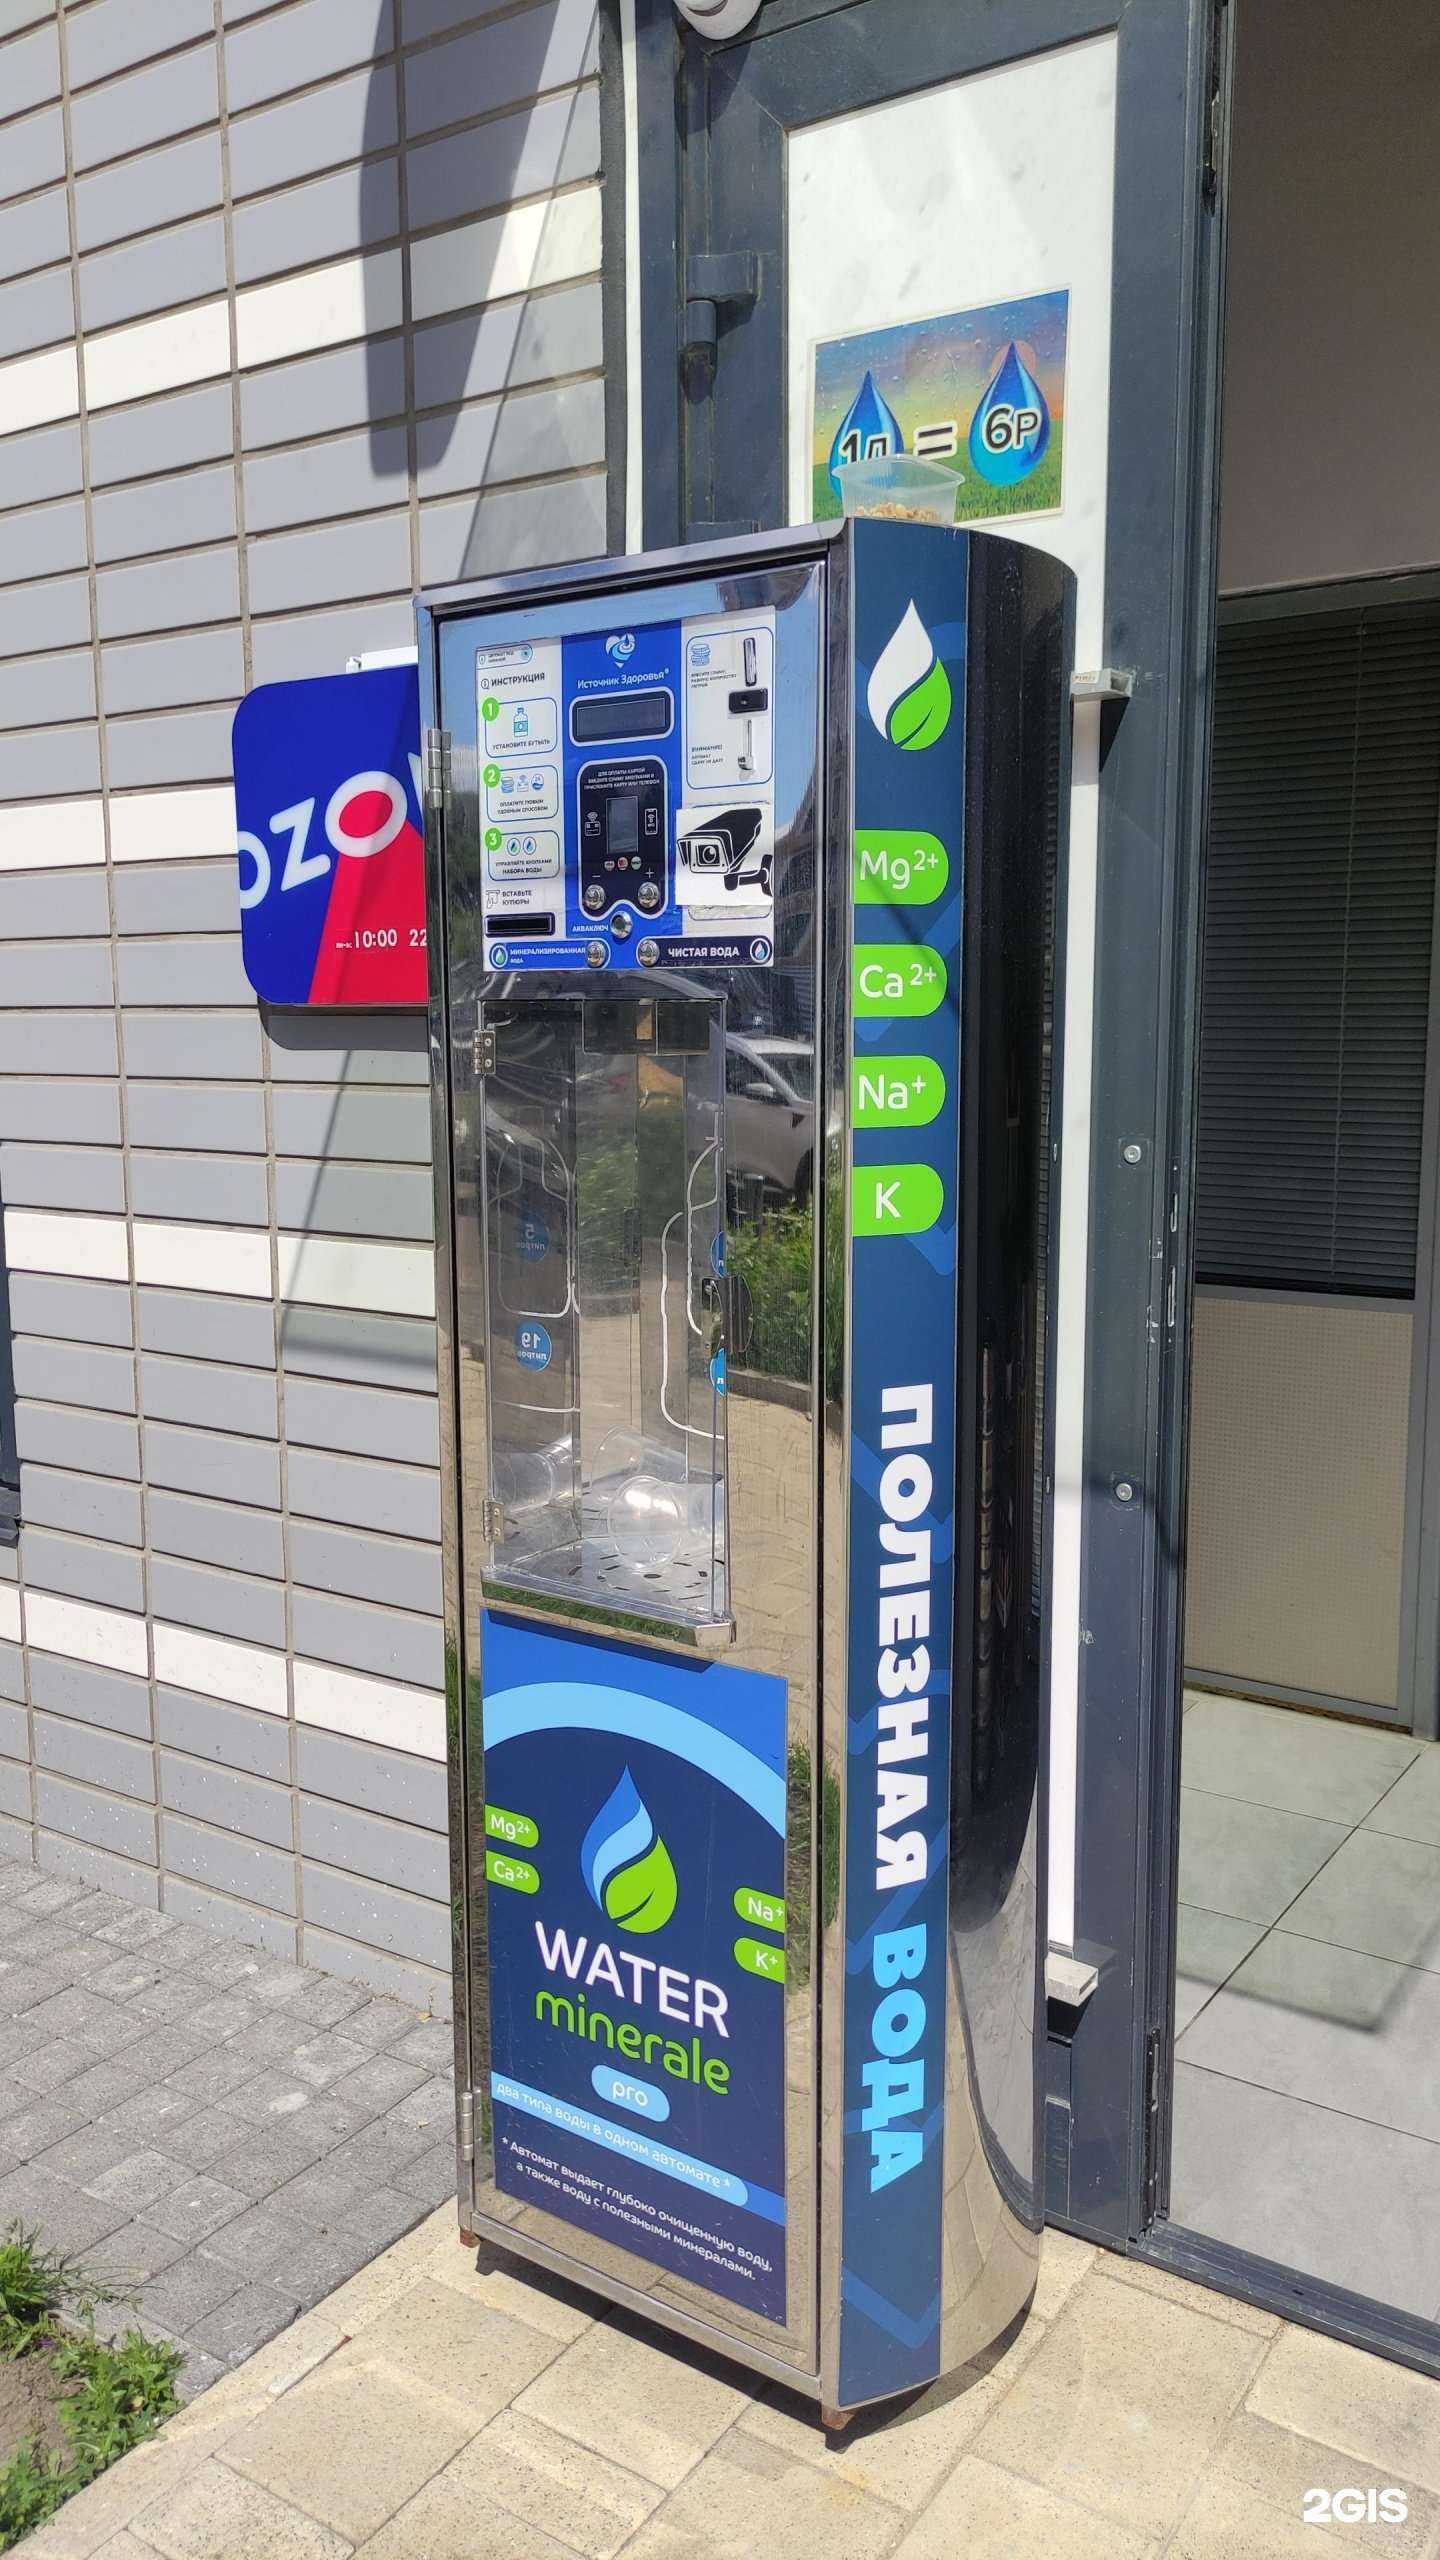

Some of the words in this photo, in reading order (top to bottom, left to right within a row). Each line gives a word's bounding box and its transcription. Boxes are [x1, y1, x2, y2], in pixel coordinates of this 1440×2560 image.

[918, 426, 953, 456] =
[492, 672, 545, 687] ИНСТРУКЦИЯ
[577, 678, 619, 689] Источник
[488, 703, 493, 717] 1
[493, 742, 527, 751] УСТАНОВИТЕ
[528, 739, 551, 747] БУТЫЛЬ
[488, 770, 496, 783] 2
[490, 833, 497, 846] 3
[502, 890, 532, 898] ВСТАВЬТЕ
[355, 928, 398, 948] 10:00
[572, 923, 609, 932] АКВАКЛЮЧ
[510, 947, 586, 956] МИНЕРАЛИЗИРОВАННАЯ
[668, 947, 708, 958] ЧИСТАЯ
[710, 947, 740, 958] ВОДА
[858, 1074, 927, 1110] Na+
[875, 1181, 902, 1220] K
[877, 1384, 934, 1891] ПОЛЕЗНАЯ
[747, 1897, 784, 1922] Na+
[755, 1949, 778, 1971] K+
[535, 1921, 730, 2038] WATER
[536, 1990, 731, 2095] minerale
[861, 1923, 928, 2193] ВОДА
[612, 2081, 649, 2107] pro
[496, 2082, 520, 2099] два
[521, 2091, 553, 2114] типа
[555, 2107, 591, 2131] воды
[593, 2123, 602, 2135] в
[604, 2127, 650, 2155] одном
[516, 2162, 523, 2172] а
[525, 2167, 561, 2190] также
[562, 2183, 592, 2205] воду
[593, 2197, 601, 2208] с
[602, 2201, 671, 2240] полезными
[673, 2232, 757, 2281] минералами.
[561, 2164, 604, 2193] выдает
[606, 2185, 656, 2216] глубоко
[658, 2210, 735, 2252] очищенную
[737, 2246, 773, 2273] воду,
